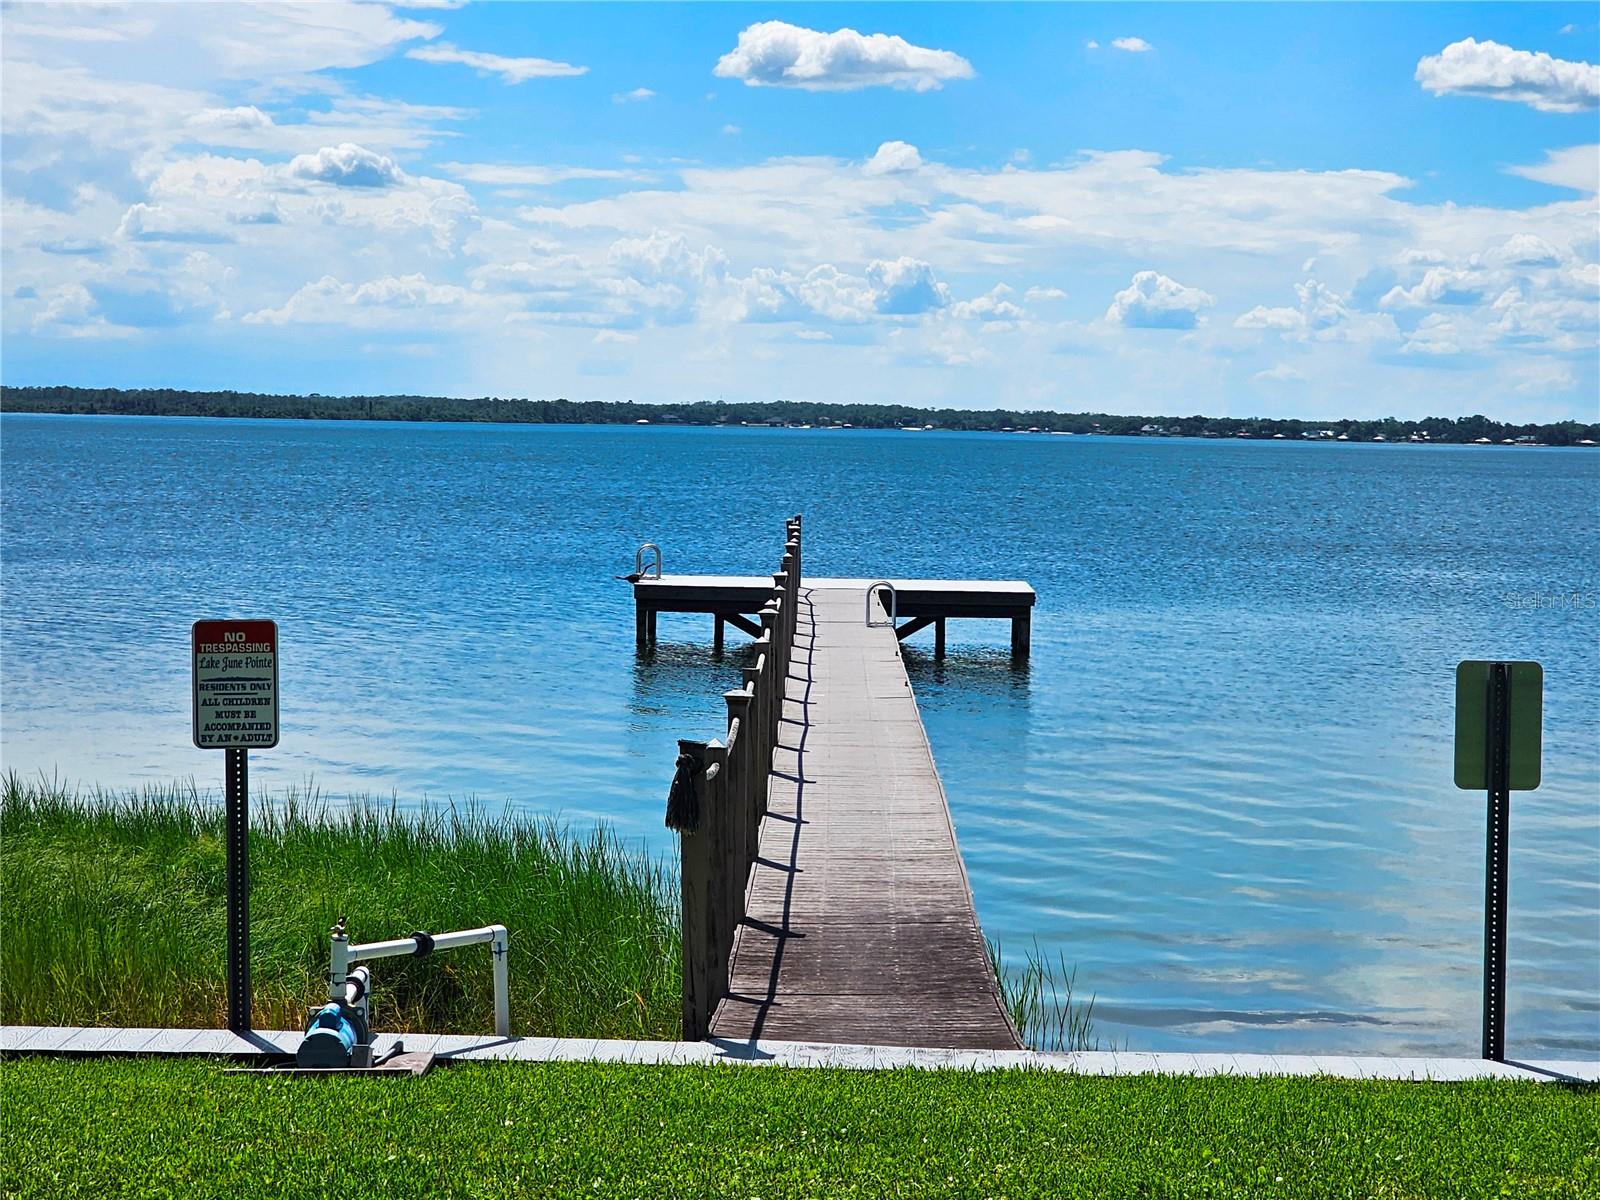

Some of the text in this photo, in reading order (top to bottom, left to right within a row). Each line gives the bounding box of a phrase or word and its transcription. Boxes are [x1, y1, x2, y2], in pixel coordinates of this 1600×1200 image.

[224, 632, 246, 642] NO
[200, 643, 271, 653] TRESPASSING
[199, 656, 272, 672] Lake June Pointe
[199, 683, 246, 691] RESIDENTS
[201, 697, 271, 706] ALL CHILDREN
[215, 710, 256, 718] MUST BE
[204, 722, 271, 731] ACCOMPANIED
[201, 734, 272, 742] BY AN ADULT
